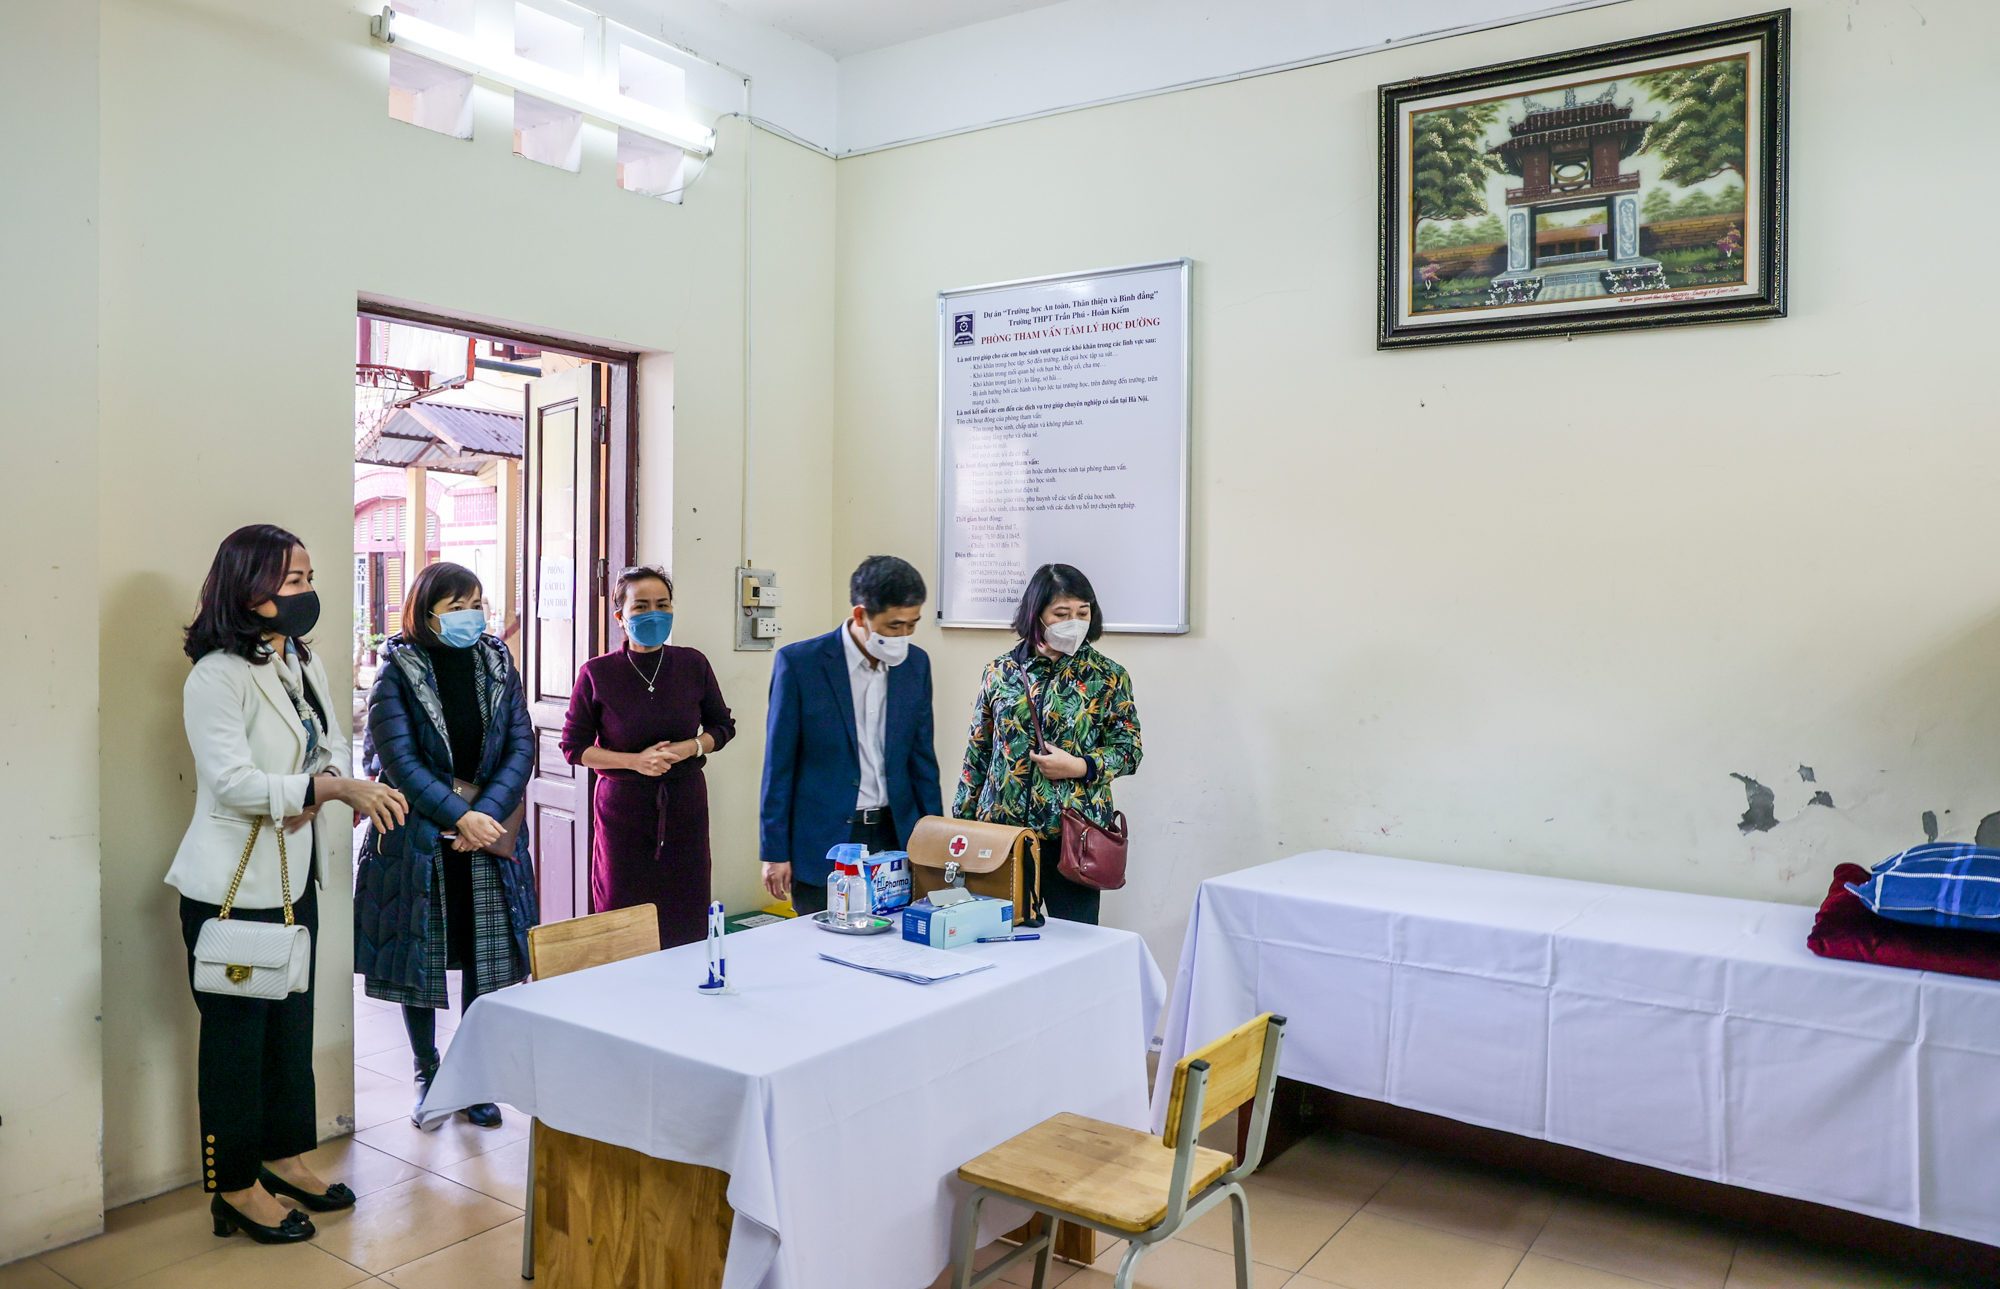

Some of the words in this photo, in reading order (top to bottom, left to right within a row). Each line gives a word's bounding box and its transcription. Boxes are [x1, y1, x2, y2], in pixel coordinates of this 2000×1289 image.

[984, 311, 992, 320] Dự
[1031, 305, 1042, 314] học
[1055, 302, 1070, 311] toàn,
[1091, 297, 1107, 307] thiện
[1009, 318, 1031, 327] Trường
[1055, 311, 1070, 320] Trần
[1111, 304, 1129, 314] Kiếm
[981, 332, 1011, 344] PHÒNG
[1014, 332, 1040, 340] THAM
[1043, 325, 1062, 338] VẤN
[1064, 324, 1084, 335] TÂM
[1087, 322, 1099, 333] LÝ
[1102, 322, 1122, 333] HỌC
[1125, 316, 1160, 328] ĐƯỜNG
[886, 878, 908, 888] Pharma
